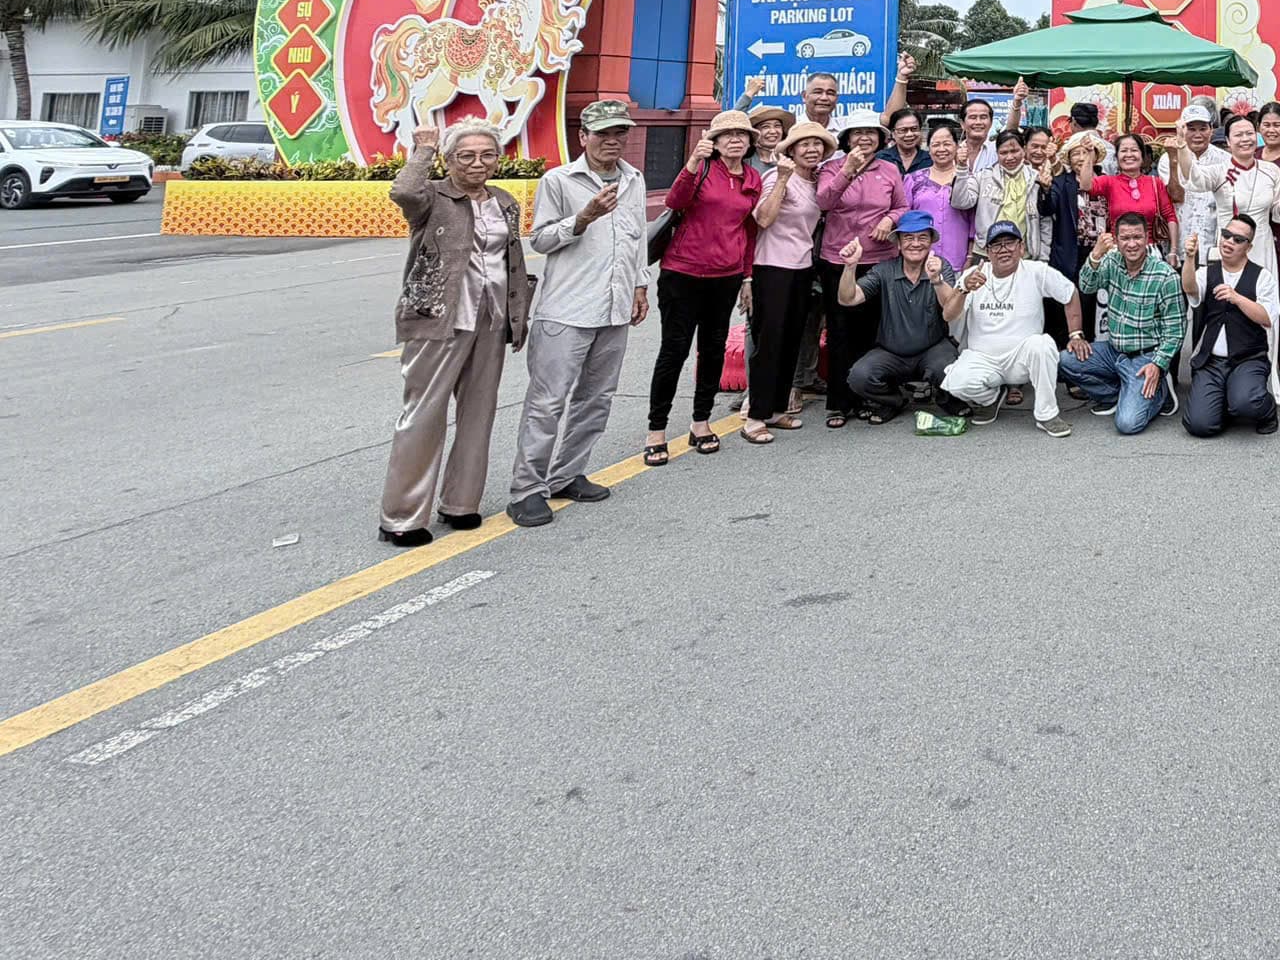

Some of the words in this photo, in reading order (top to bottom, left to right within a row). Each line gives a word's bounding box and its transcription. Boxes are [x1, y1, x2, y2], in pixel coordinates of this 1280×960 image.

[297, 0, 313, 21] SỰ
[770, 8, 826, 25] PARKING
[830, 7, 854, 22] LOT
[288, 45, 313, 64] NHƯ
[290, 92, 300, 114] Ý
[1152, 93, 1182, 110] XUÂN
